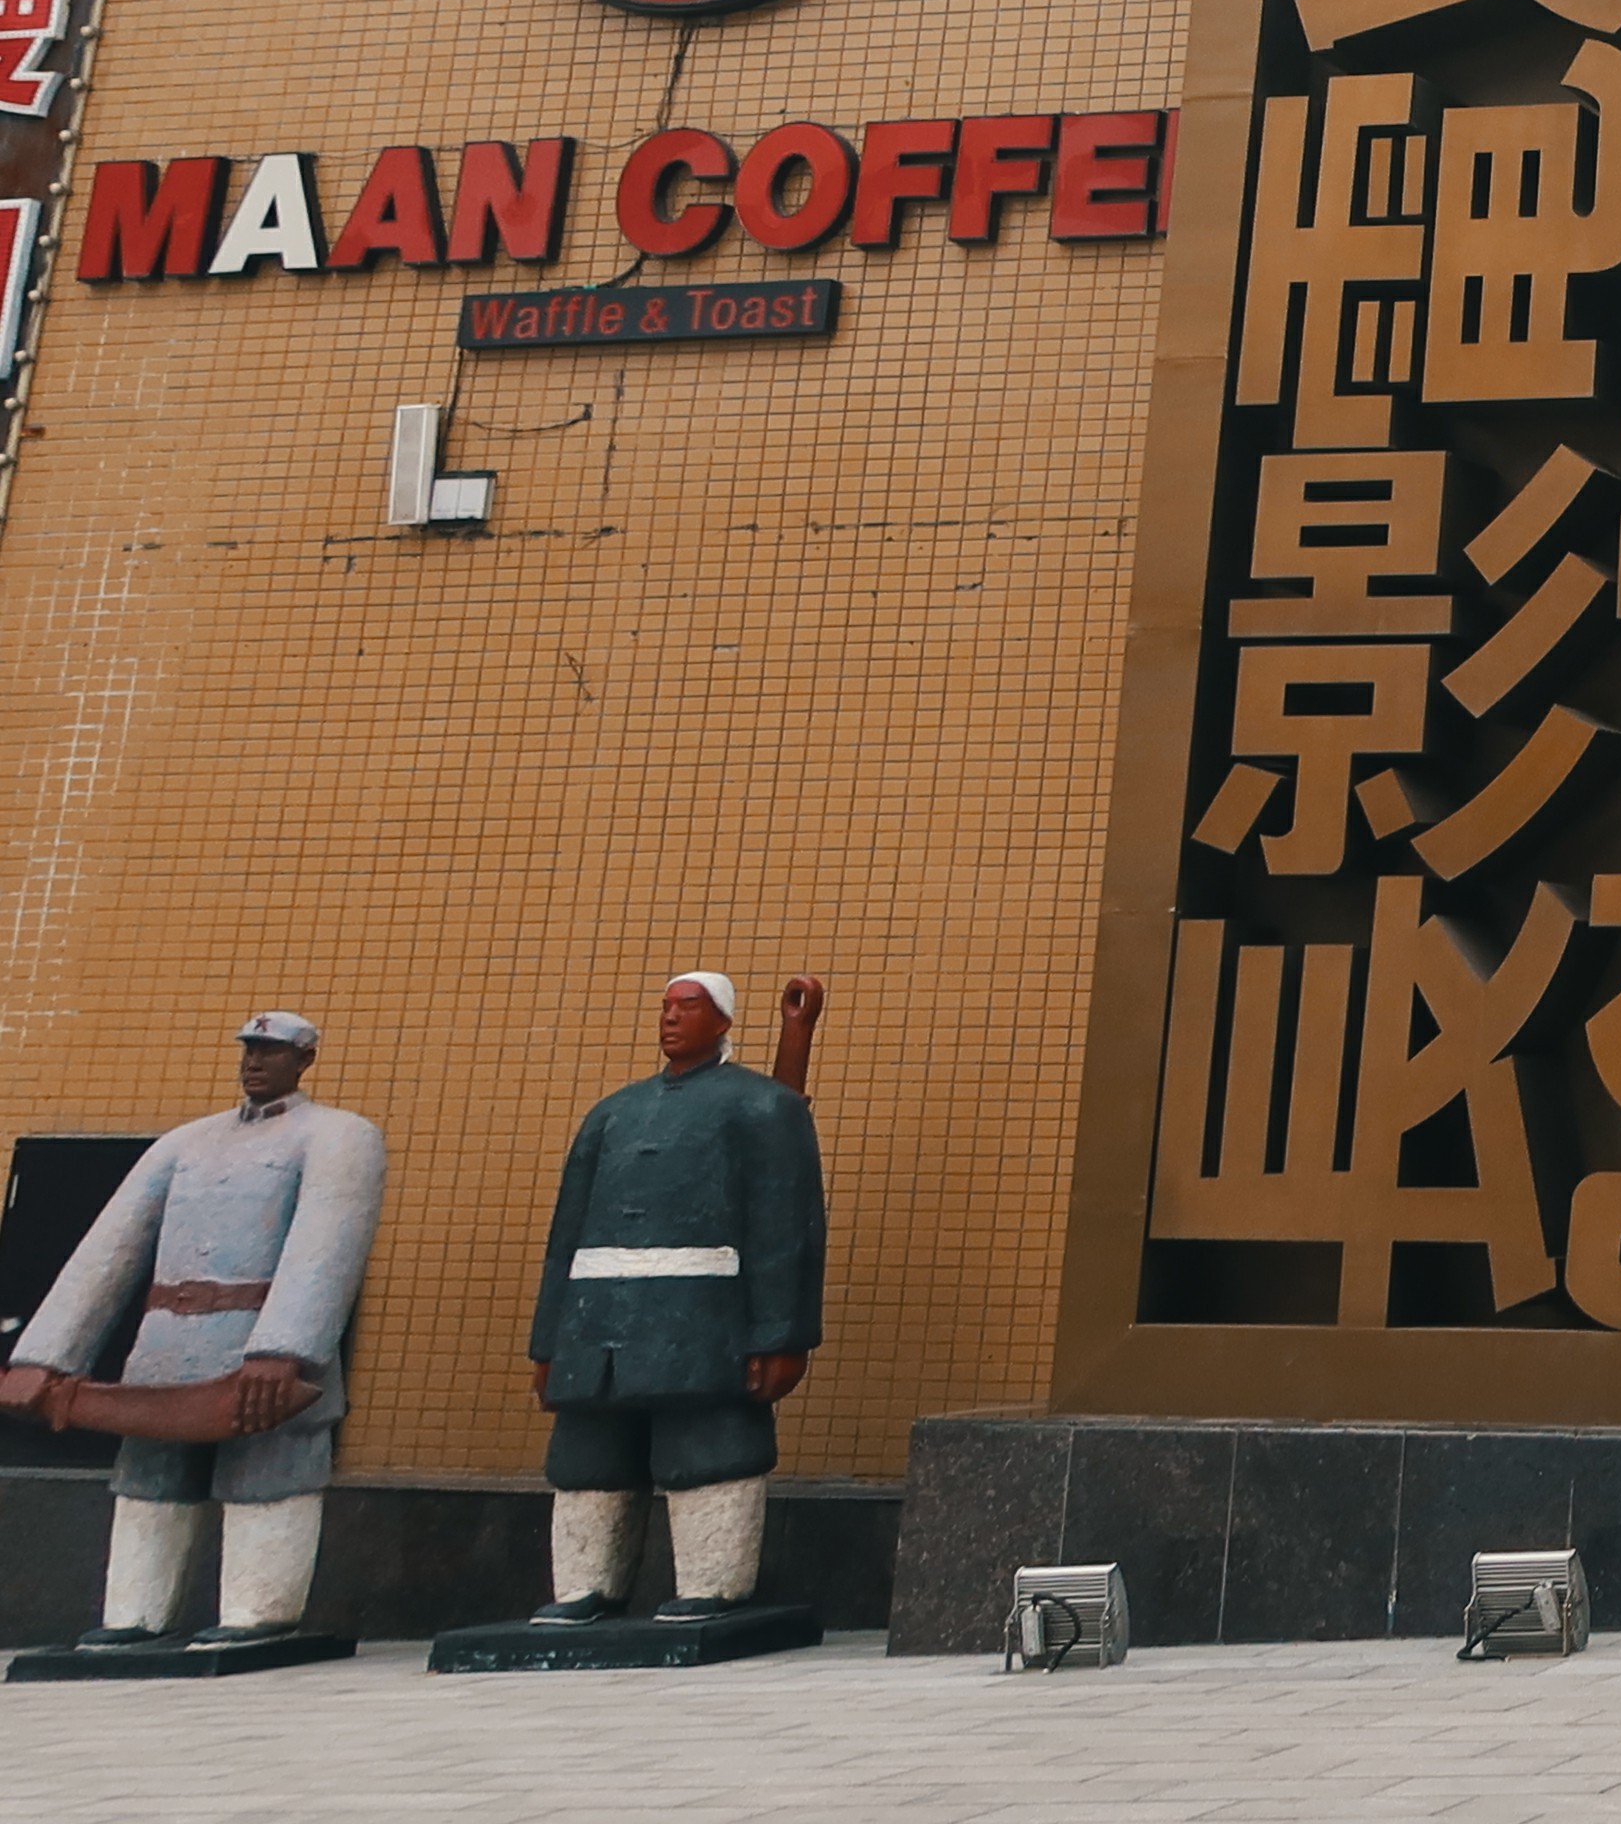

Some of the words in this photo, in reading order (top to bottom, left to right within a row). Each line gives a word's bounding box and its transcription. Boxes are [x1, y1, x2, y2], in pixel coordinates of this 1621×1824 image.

[76, 135, 576, 283] MAAN
[615, 107, 1178, 256] COFFE
[471, 295, 626, 340] Waffle
[638, 297, 668, 334] &
[687, 286, 818, 331] Toast
